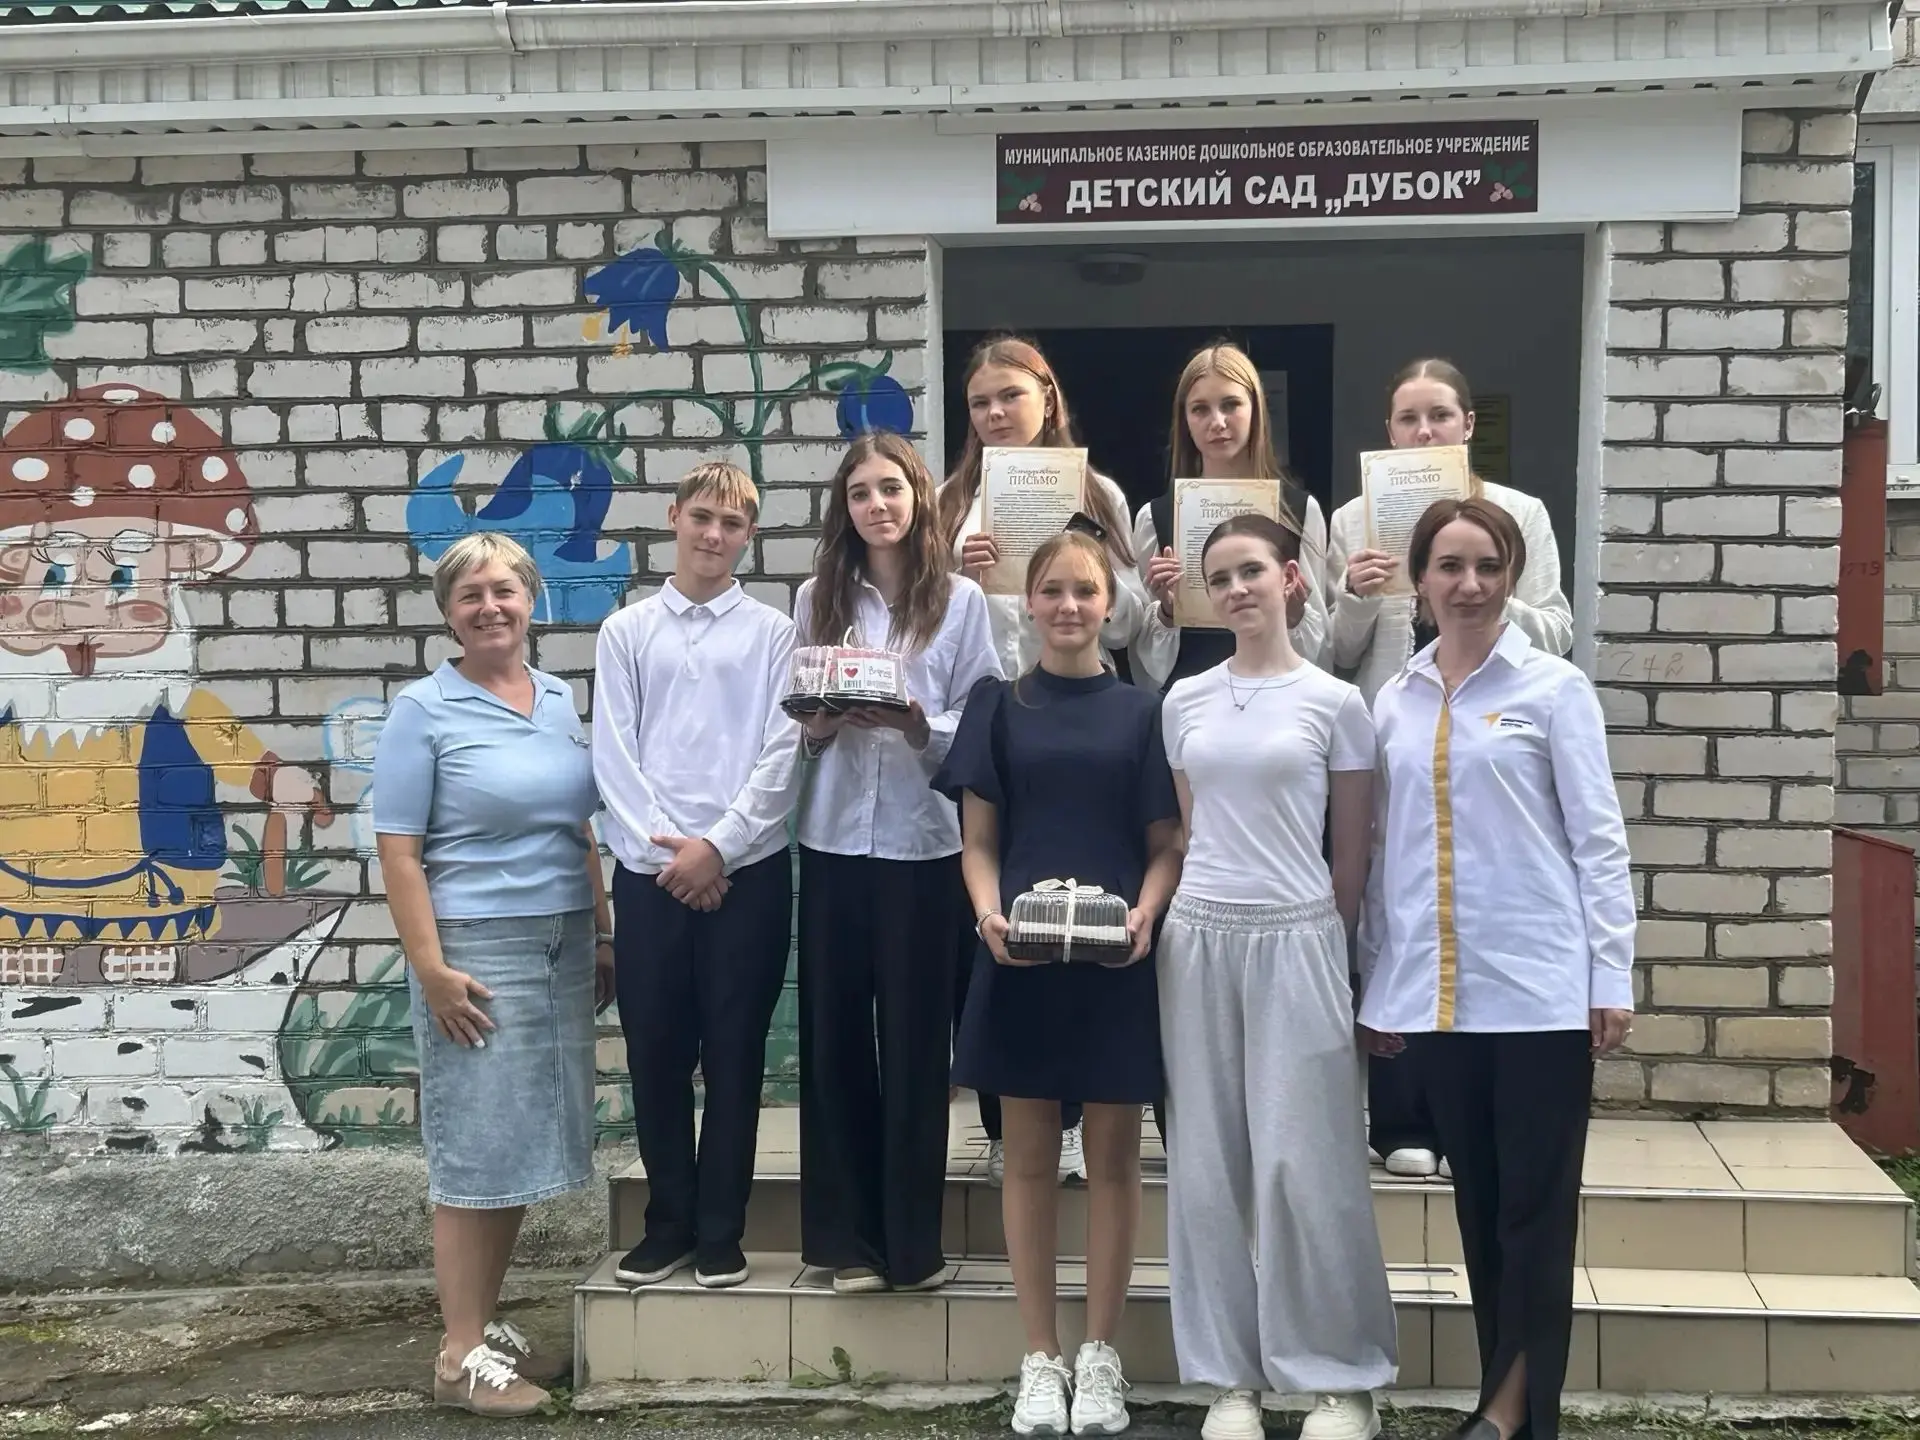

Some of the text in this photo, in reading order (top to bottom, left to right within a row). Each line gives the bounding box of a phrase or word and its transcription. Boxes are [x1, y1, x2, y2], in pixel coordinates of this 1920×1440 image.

[1005, 135, 1530, 166] МУНИЦИПАЛЬНОЕ КАЗЕННОЕ ДОШКОЛЬНОЕ ОБРАЗОВАТЕЛЬНОЕ УЧРЕЖДЕНИЕ
[1066, 169, 1231, 214] ДЕТСКИЙ
[1244, 174, 1317, 209] САД
